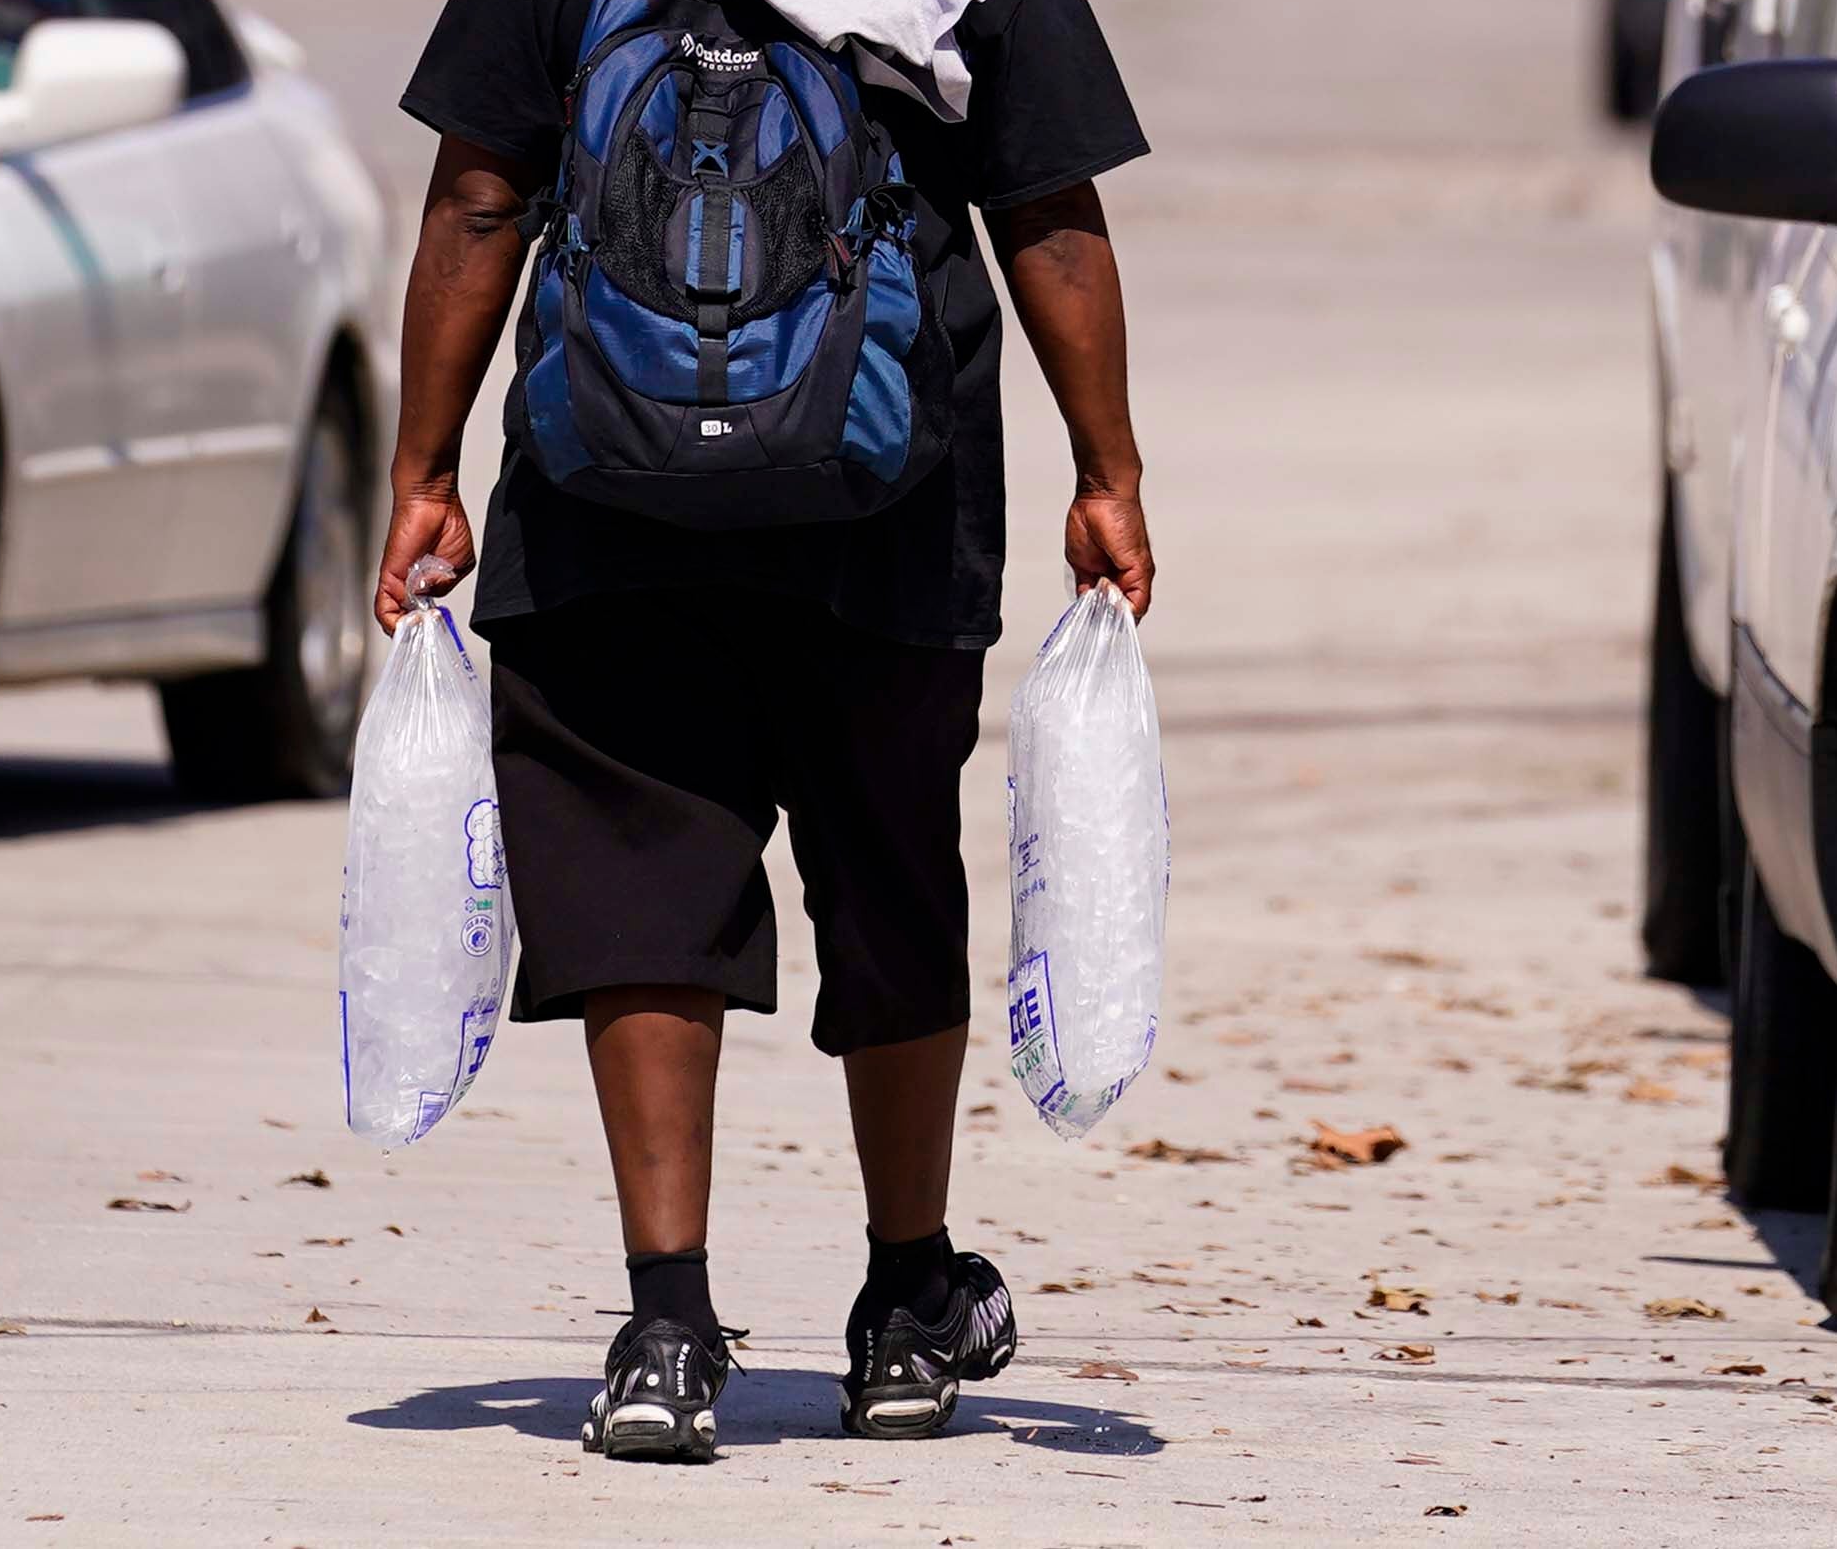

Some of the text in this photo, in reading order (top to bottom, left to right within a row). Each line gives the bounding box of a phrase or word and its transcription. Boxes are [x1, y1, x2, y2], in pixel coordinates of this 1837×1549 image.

[696, 43, 759, 64] Outdoor
[866, 1329, 874, 1356] MAX
[676, 1343, 691, 1397] MAX AIR
